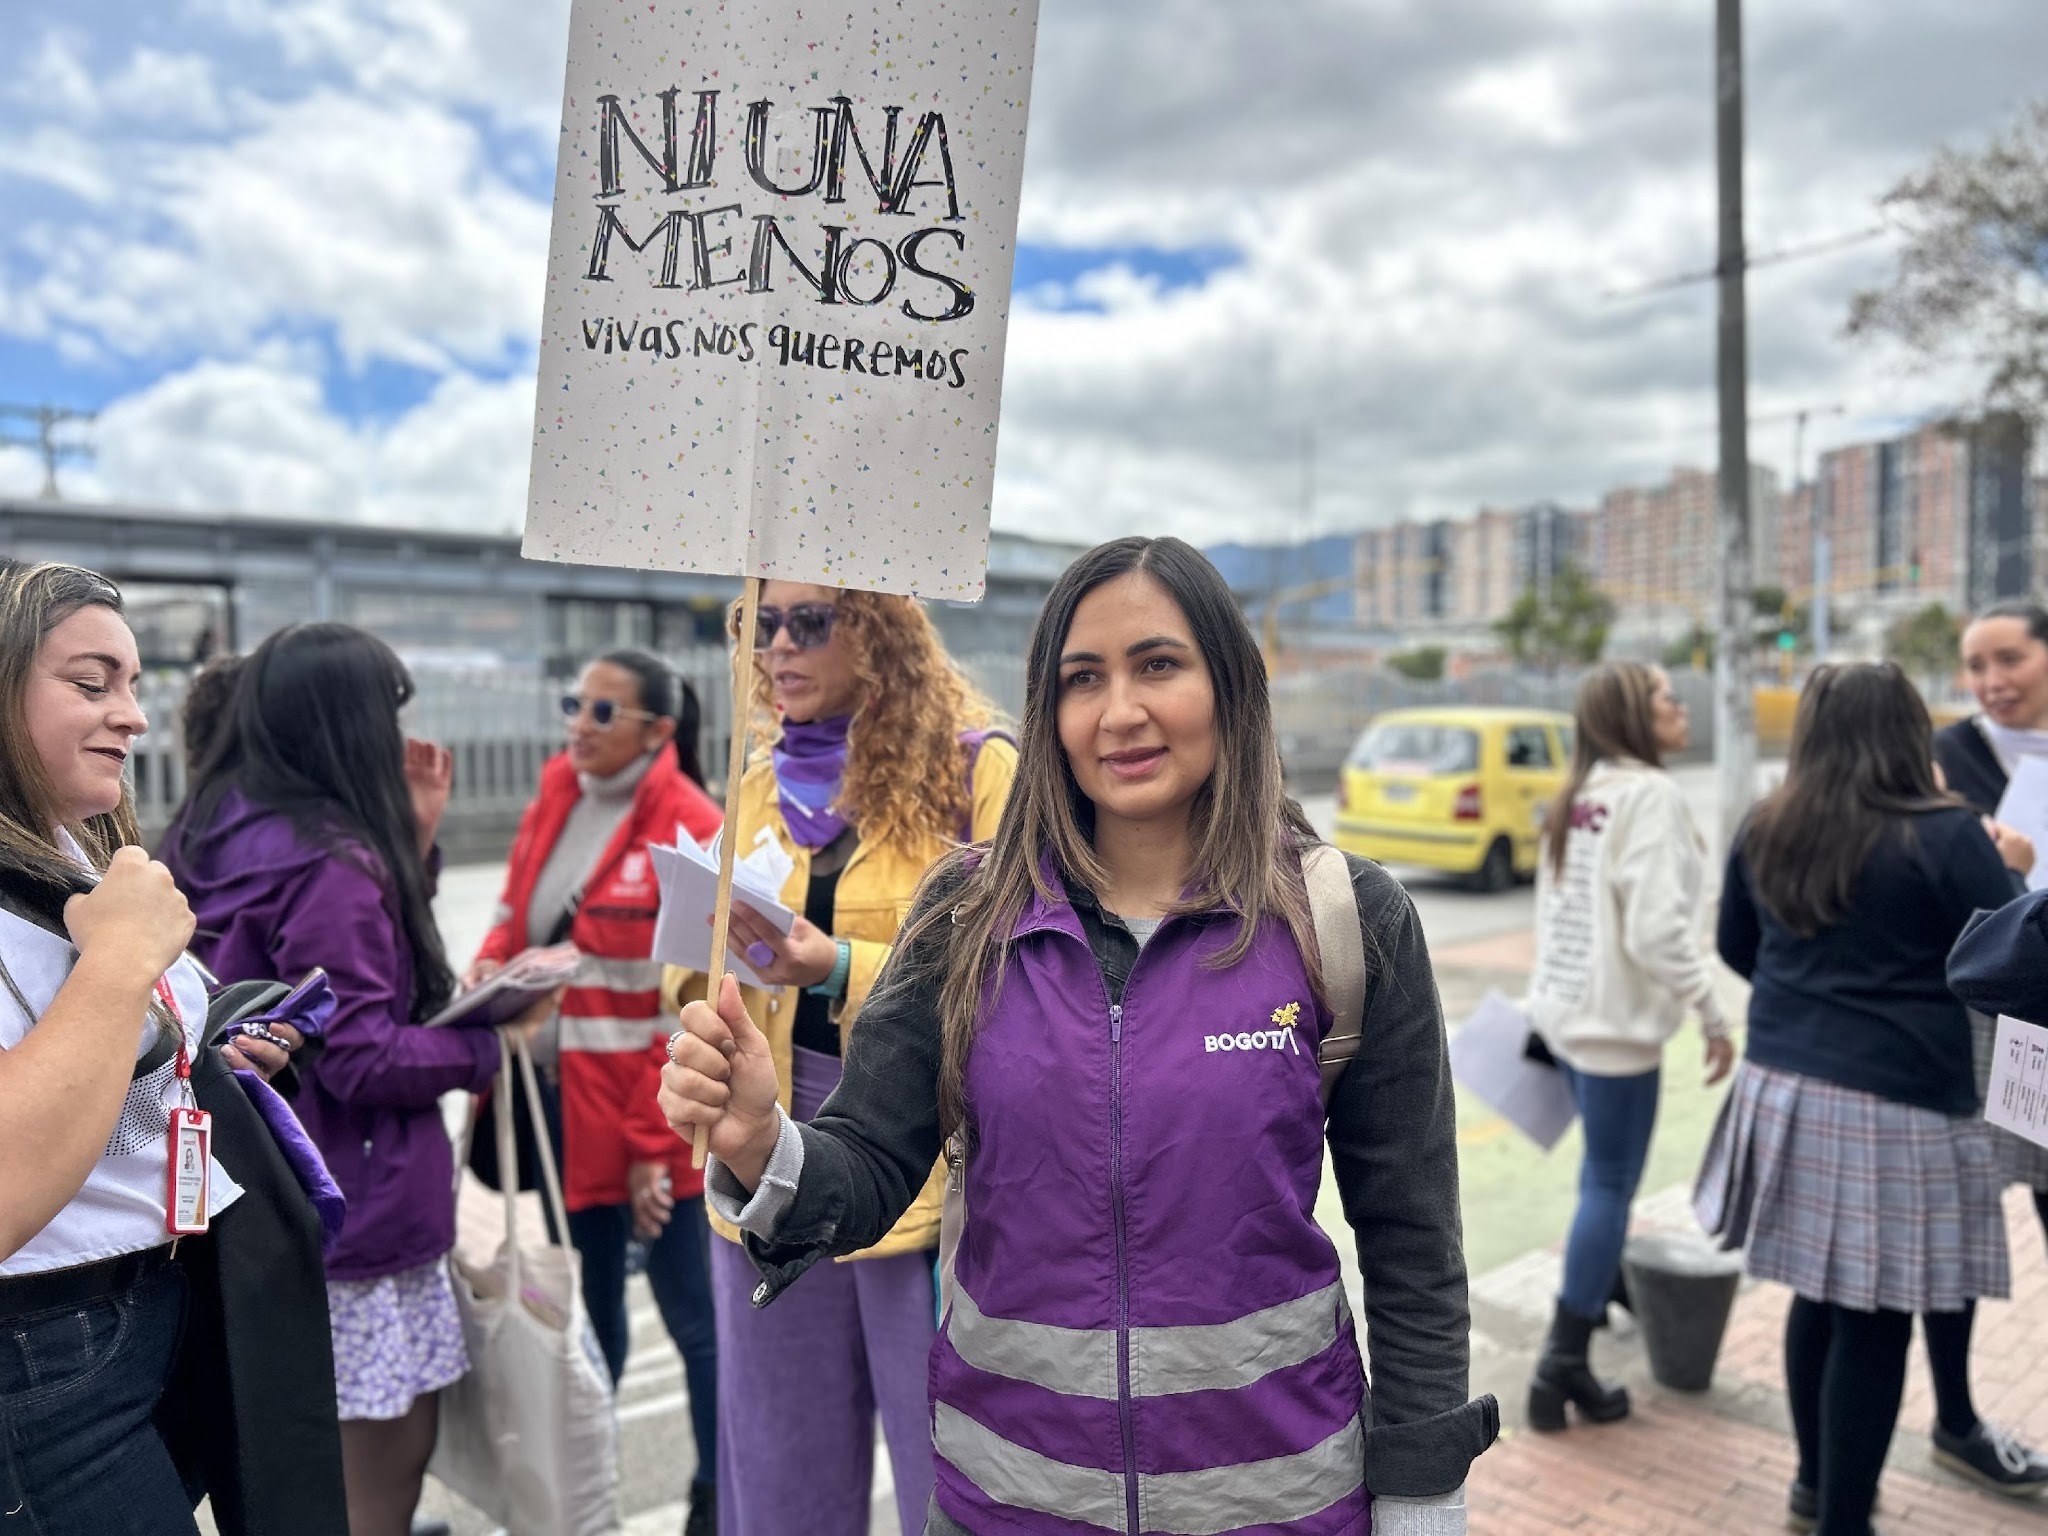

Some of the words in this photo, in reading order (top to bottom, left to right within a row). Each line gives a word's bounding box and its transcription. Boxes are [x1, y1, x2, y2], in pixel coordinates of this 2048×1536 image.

[594, 86, 720, 199] NI
[745, 97, 965, 220] UNA
[582, 203, 974, 322] MENOS
